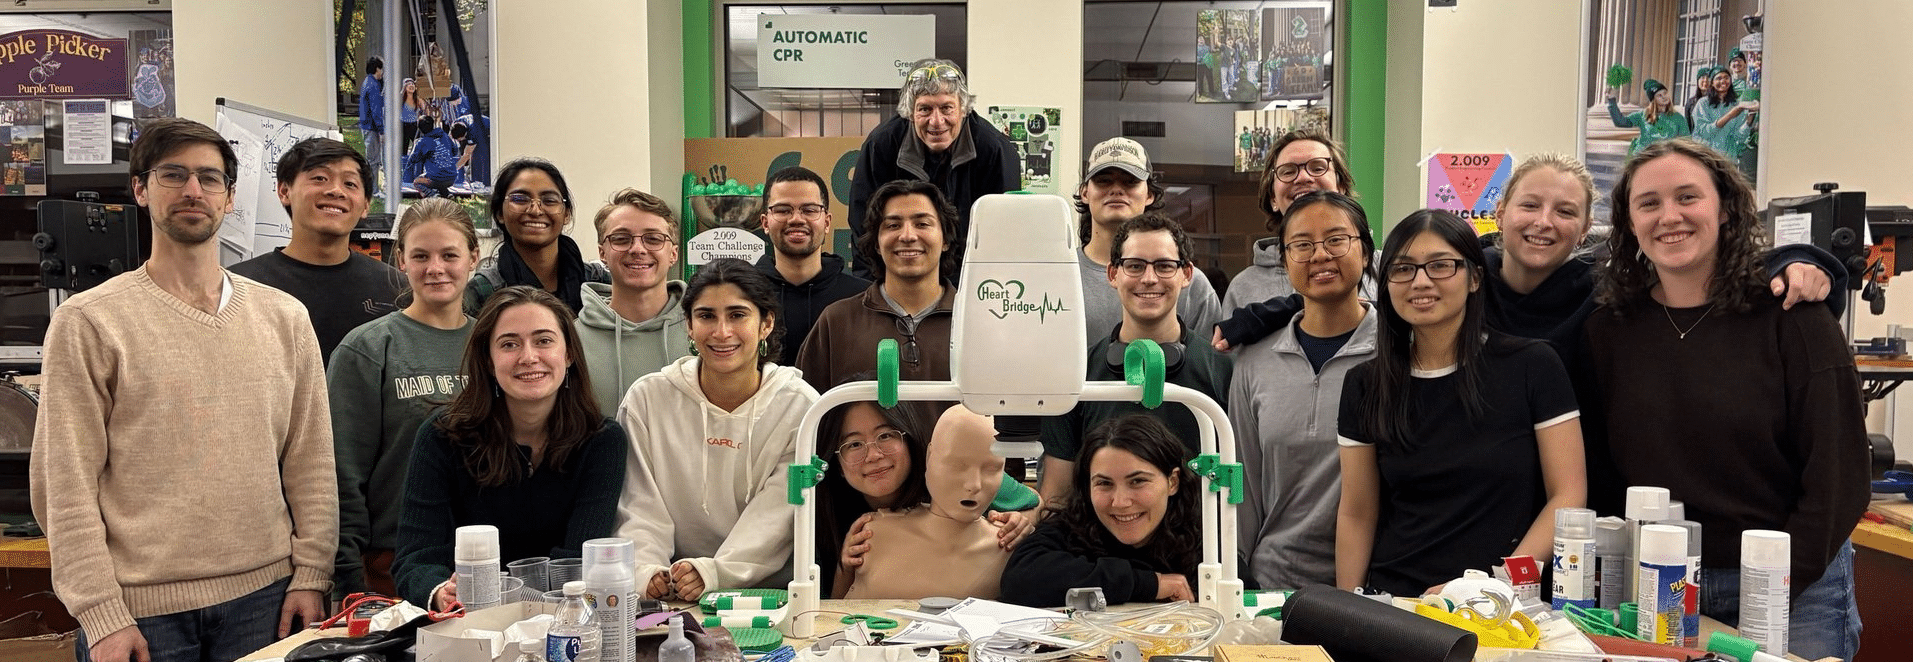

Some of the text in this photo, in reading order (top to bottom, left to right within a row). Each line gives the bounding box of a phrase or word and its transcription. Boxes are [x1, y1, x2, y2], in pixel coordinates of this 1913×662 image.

[773, 31, 868, 43] AUTOMATIC
[46, 34, 111, 61] Picker
[773, 49, 803, 61] CPR
[894, 59, 916, 68] Gree
[18, 83, 74, 95] Purple Team
[1450, 155, 1490, 167] 2.009
[713, 231, 737, 240] 2.009
[689, 241, 763, 252] Team Challenge
[701, 252, 752, 261] Champions
[982, 286, 1010, 300] Heart
[1003, 299, 1036, 315] Bridge
[395, 375, 435, 399] MAID
[436, 375, 455, 395] OF
